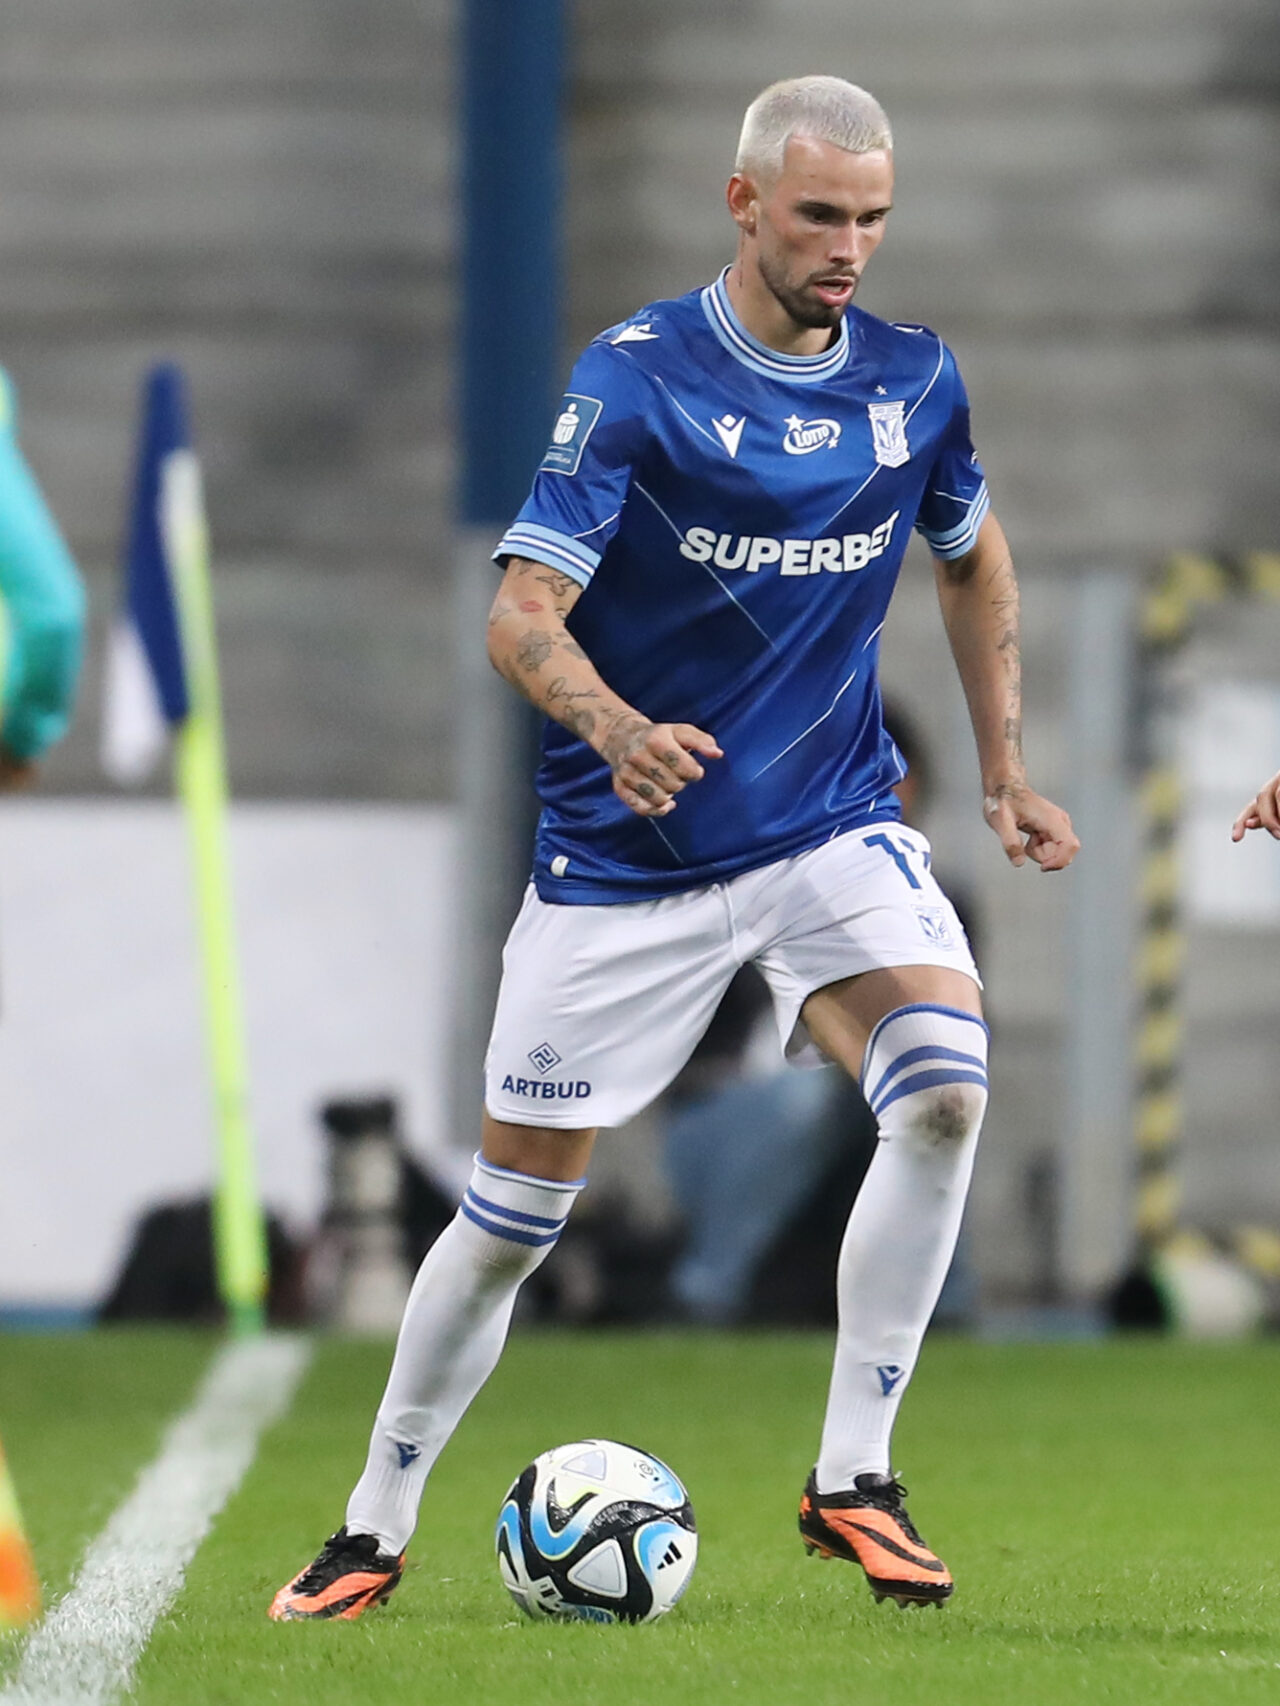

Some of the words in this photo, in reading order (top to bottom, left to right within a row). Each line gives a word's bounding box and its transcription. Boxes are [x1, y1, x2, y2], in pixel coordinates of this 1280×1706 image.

[793, 425, 831, 448] LOTTO
[679, 509, 900, 576] SUPERBET
[501, 1074, 592, 1099] ARTBUD
